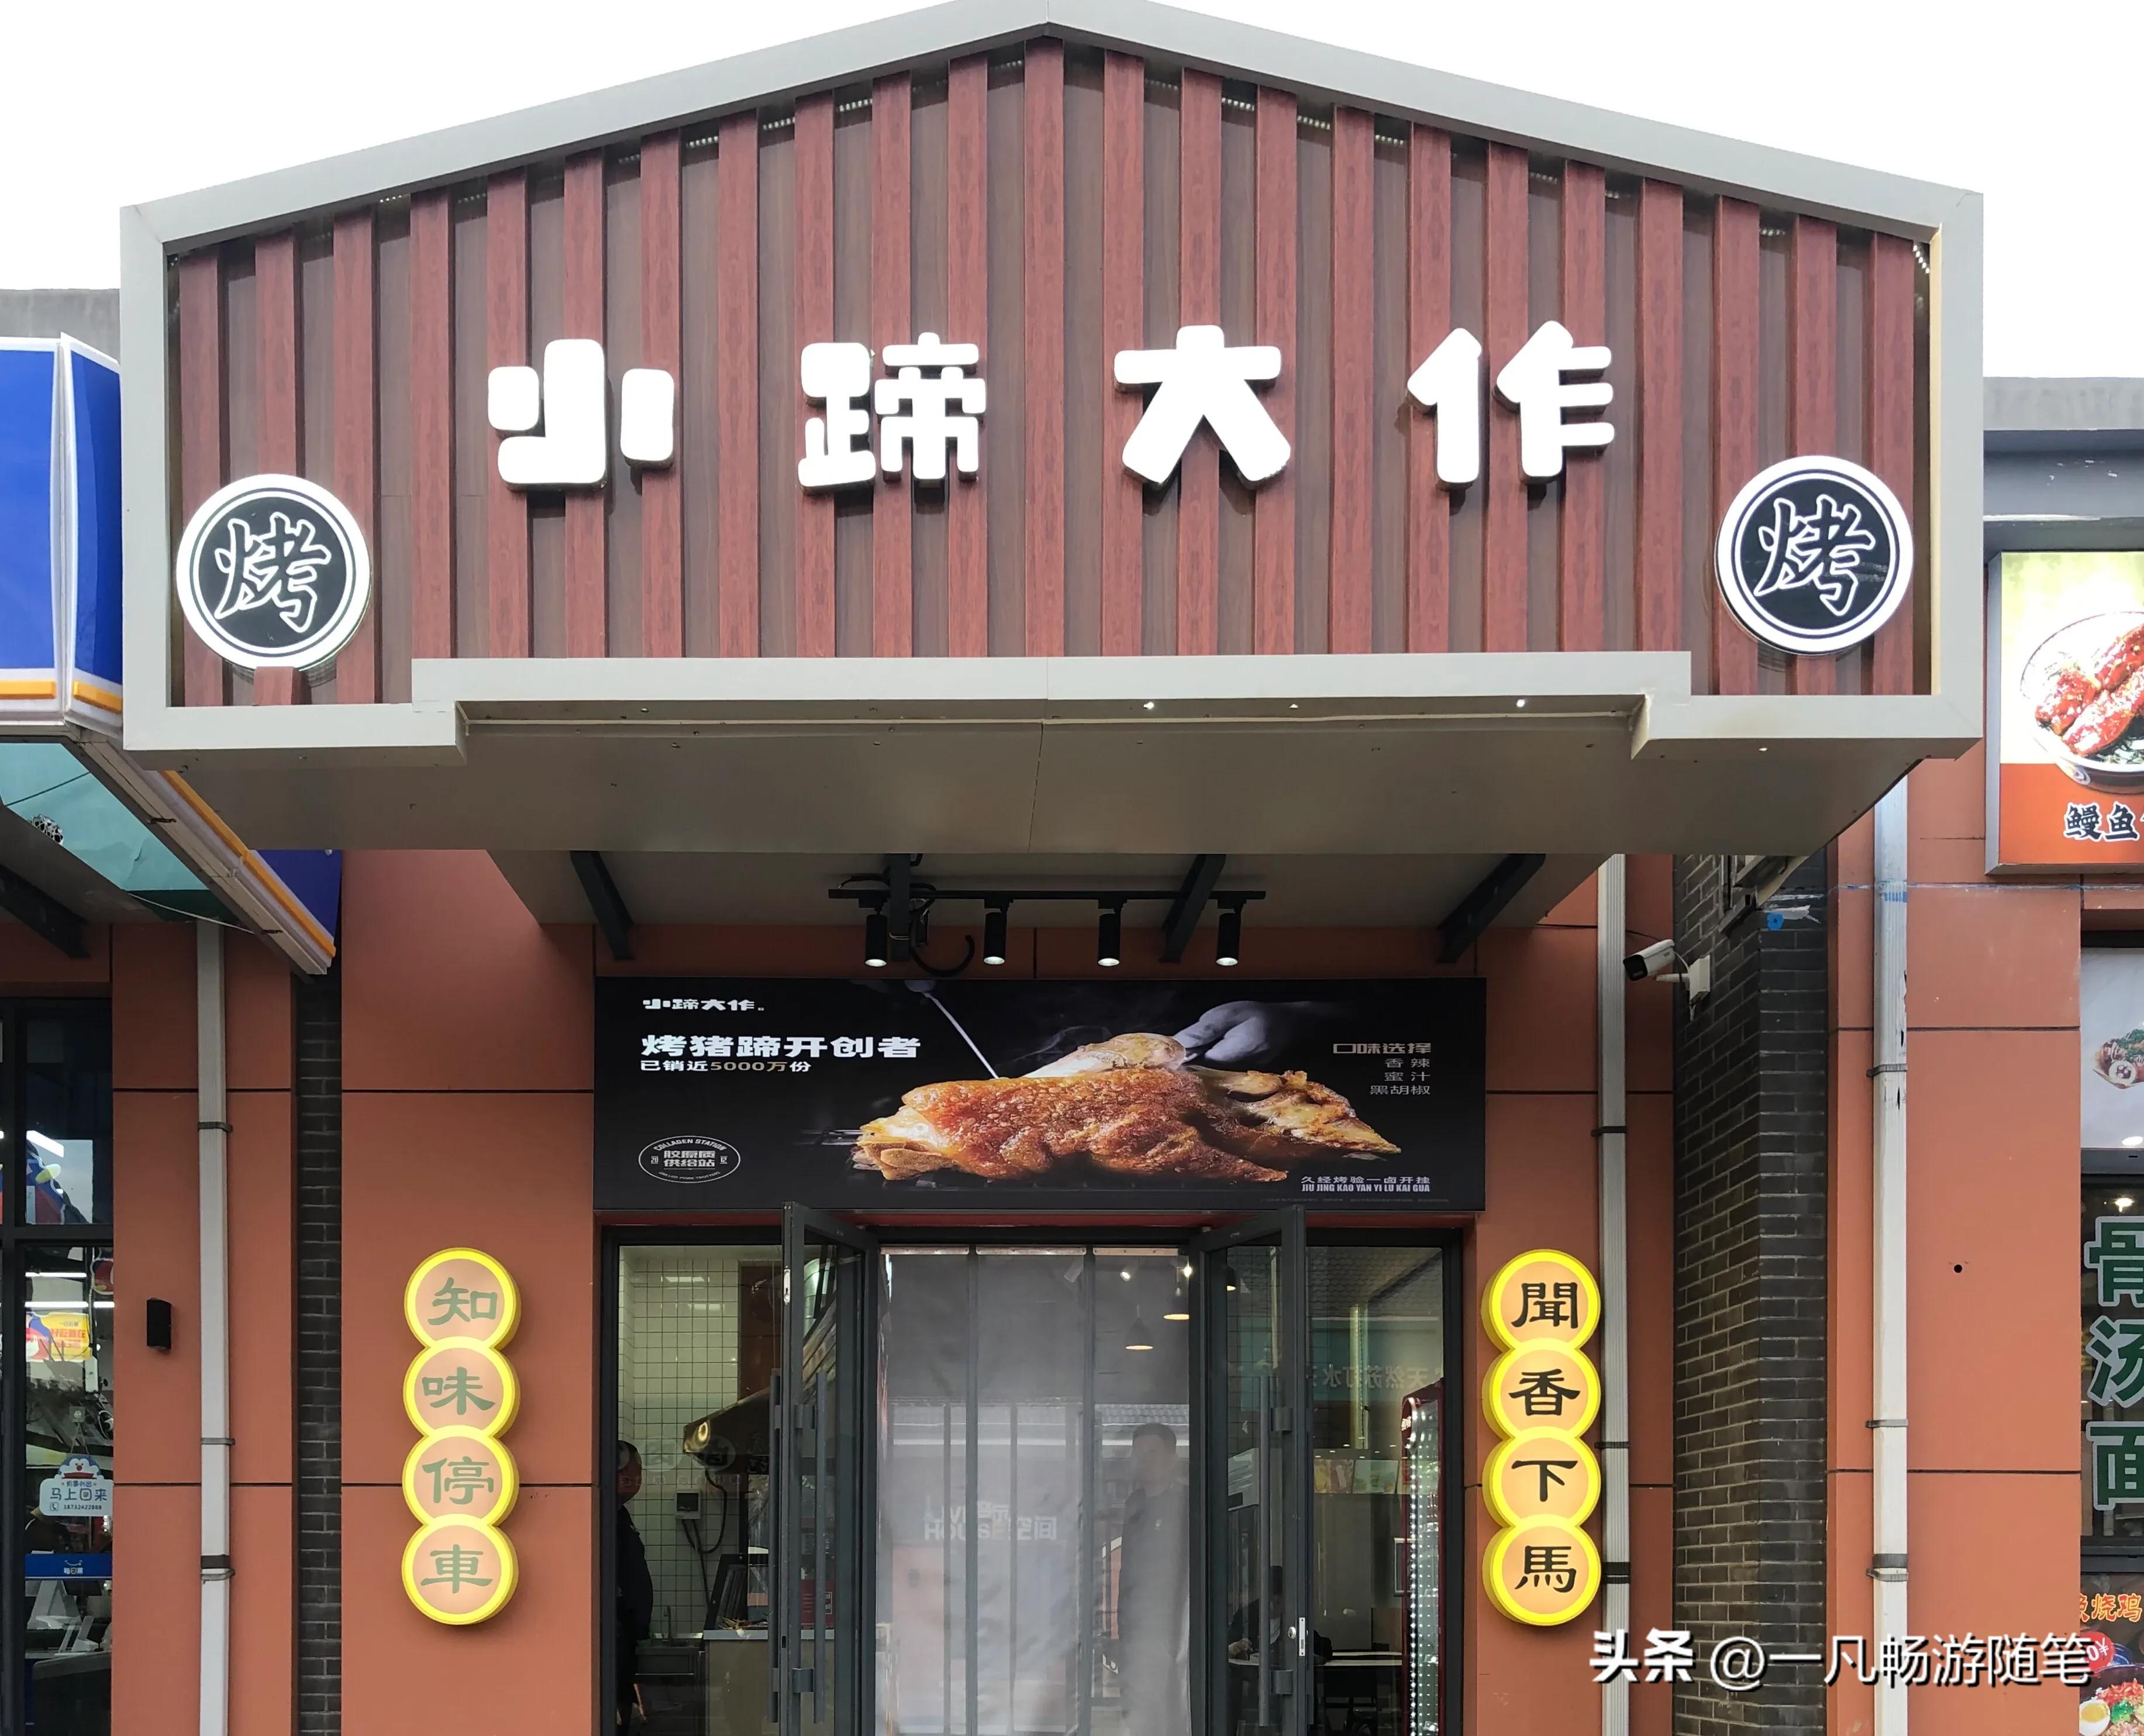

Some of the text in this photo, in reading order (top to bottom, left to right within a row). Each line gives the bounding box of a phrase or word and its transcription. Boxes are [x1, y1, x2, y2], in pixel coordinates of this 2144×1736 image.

[487, 320, 1616, 489] 小蹄大作
[1754, 494, 1876, 616] 烤
[214, 511, 332, 633] 烤
[2063, 801, 2144, 842] 鳗鱼
[640, 1035, 921, 1058] 烤猪蹄开创者
[1333, 1043, 1431, 1054] 口味选择
[640, 1060, 812, 1072] 已销近5000万份
[1369, 1085, 1431, 1095] 黑胡椒
[695, 1139, 728, 1151] STATION
[663, 1159, 715, 1167] 供给站
[1302, 1184, 1315, 1192] JIU
[1316, 1184, 1335, 1192] JING
[1337, 1184, 1354, 1192] KAO
[1357, 1184, 1371, 1192] YAN
[1374, 1184, 1382, 1192] YI
[1396, 1184, 1411, 1192] KAI
[1412, 1184, 1430, 1192] GUA
[2084, 1216, 2144, 1511] 骨汤面
[420, 1277, 498, 1594] 知味停車
[1508, 1282, 1580, 1593] 聞香下馬
[50, 1488, 108, 1501] 马上回来
